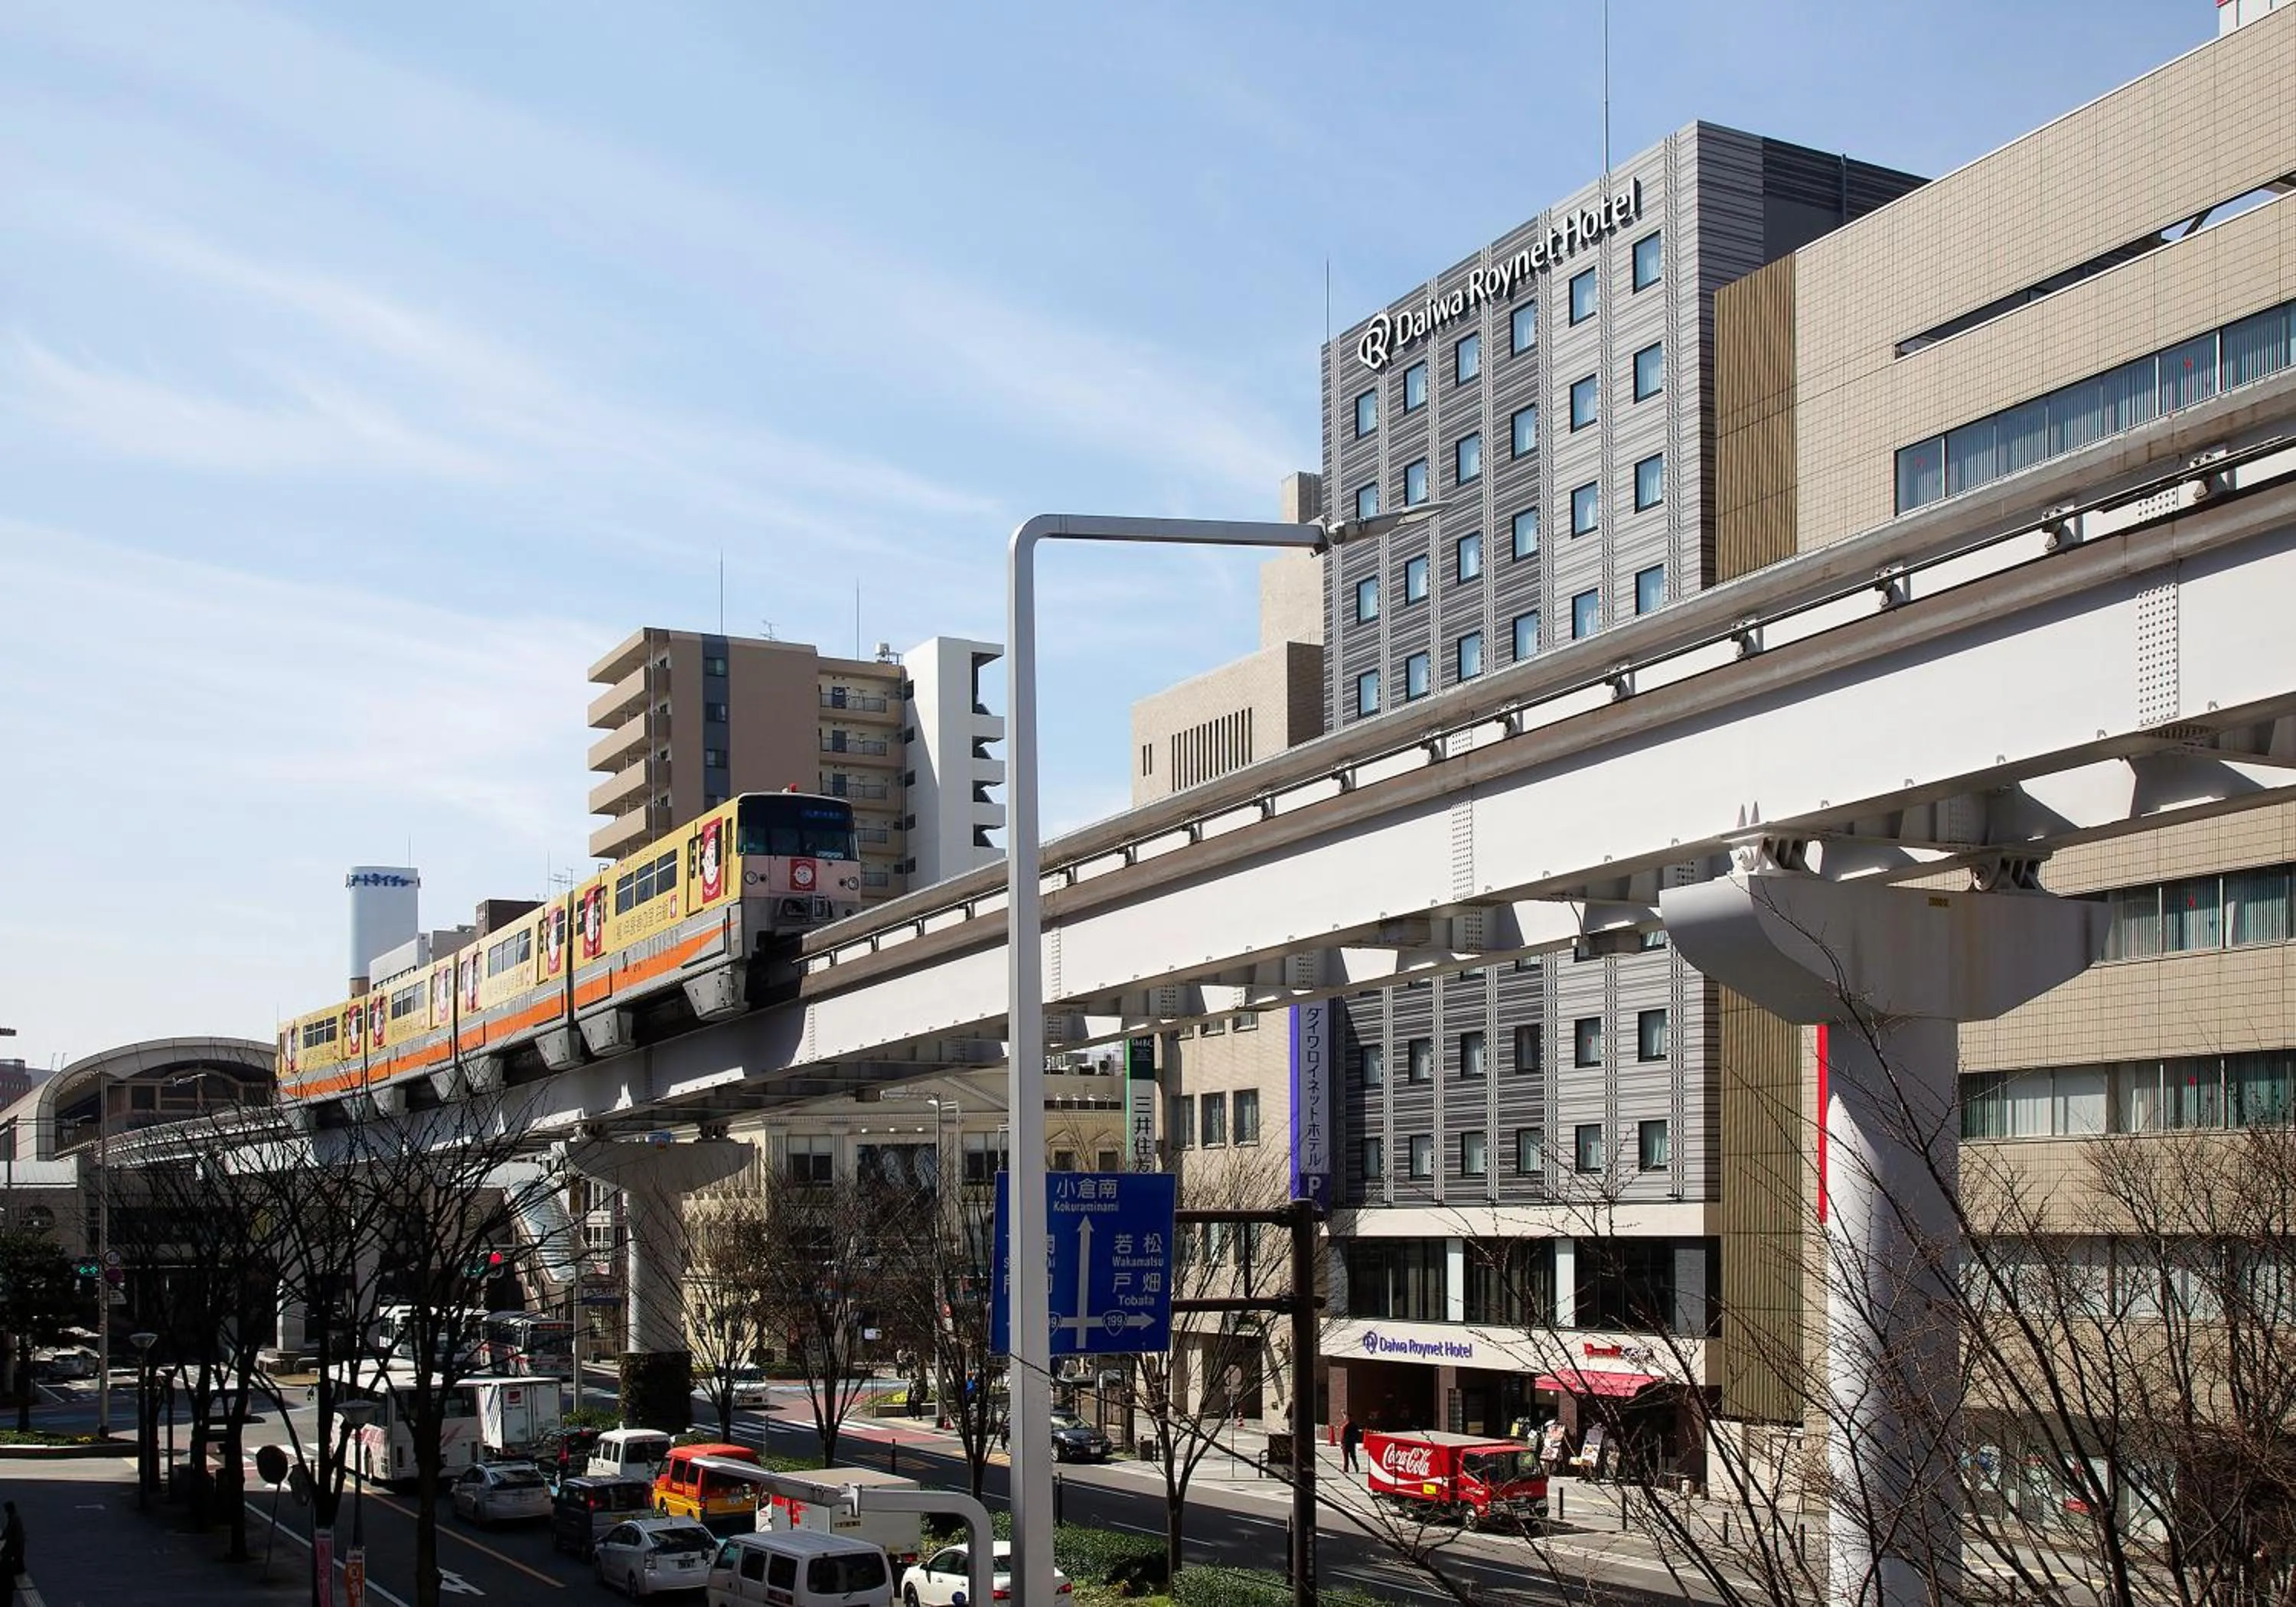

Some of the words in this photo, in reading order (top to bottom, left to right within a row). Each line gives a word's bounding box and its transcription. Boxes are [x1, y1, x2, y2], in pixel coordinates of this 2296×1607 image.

[1397, 289, 1464, 346] Daiwa
[1469, 228, 1557, 304] Roynet
[1563, 176, 1637, 251] Hotel
[1056, 1178, 1118, 1199] 小倉南
[1307, 1175, 1322, 1197] P
[1053, 1200, 1120, 1213] Kokuraminami
[1114, 1233, 1163, 1254] 若松
[1112, 1255, 1164, 1267] Wakamatsu
[1112, 1273, 1161, 1293] 戸畑
[1118, 1295, 1155, 1306] Tobata
[1107, 1315, 1123, 1327] 199
[1380, 1337, 1407, 1353] Daiwa
[1409, 1339, 1443, 1358] Roynet
[1444, 1341, 1473, 1358] Hotel
